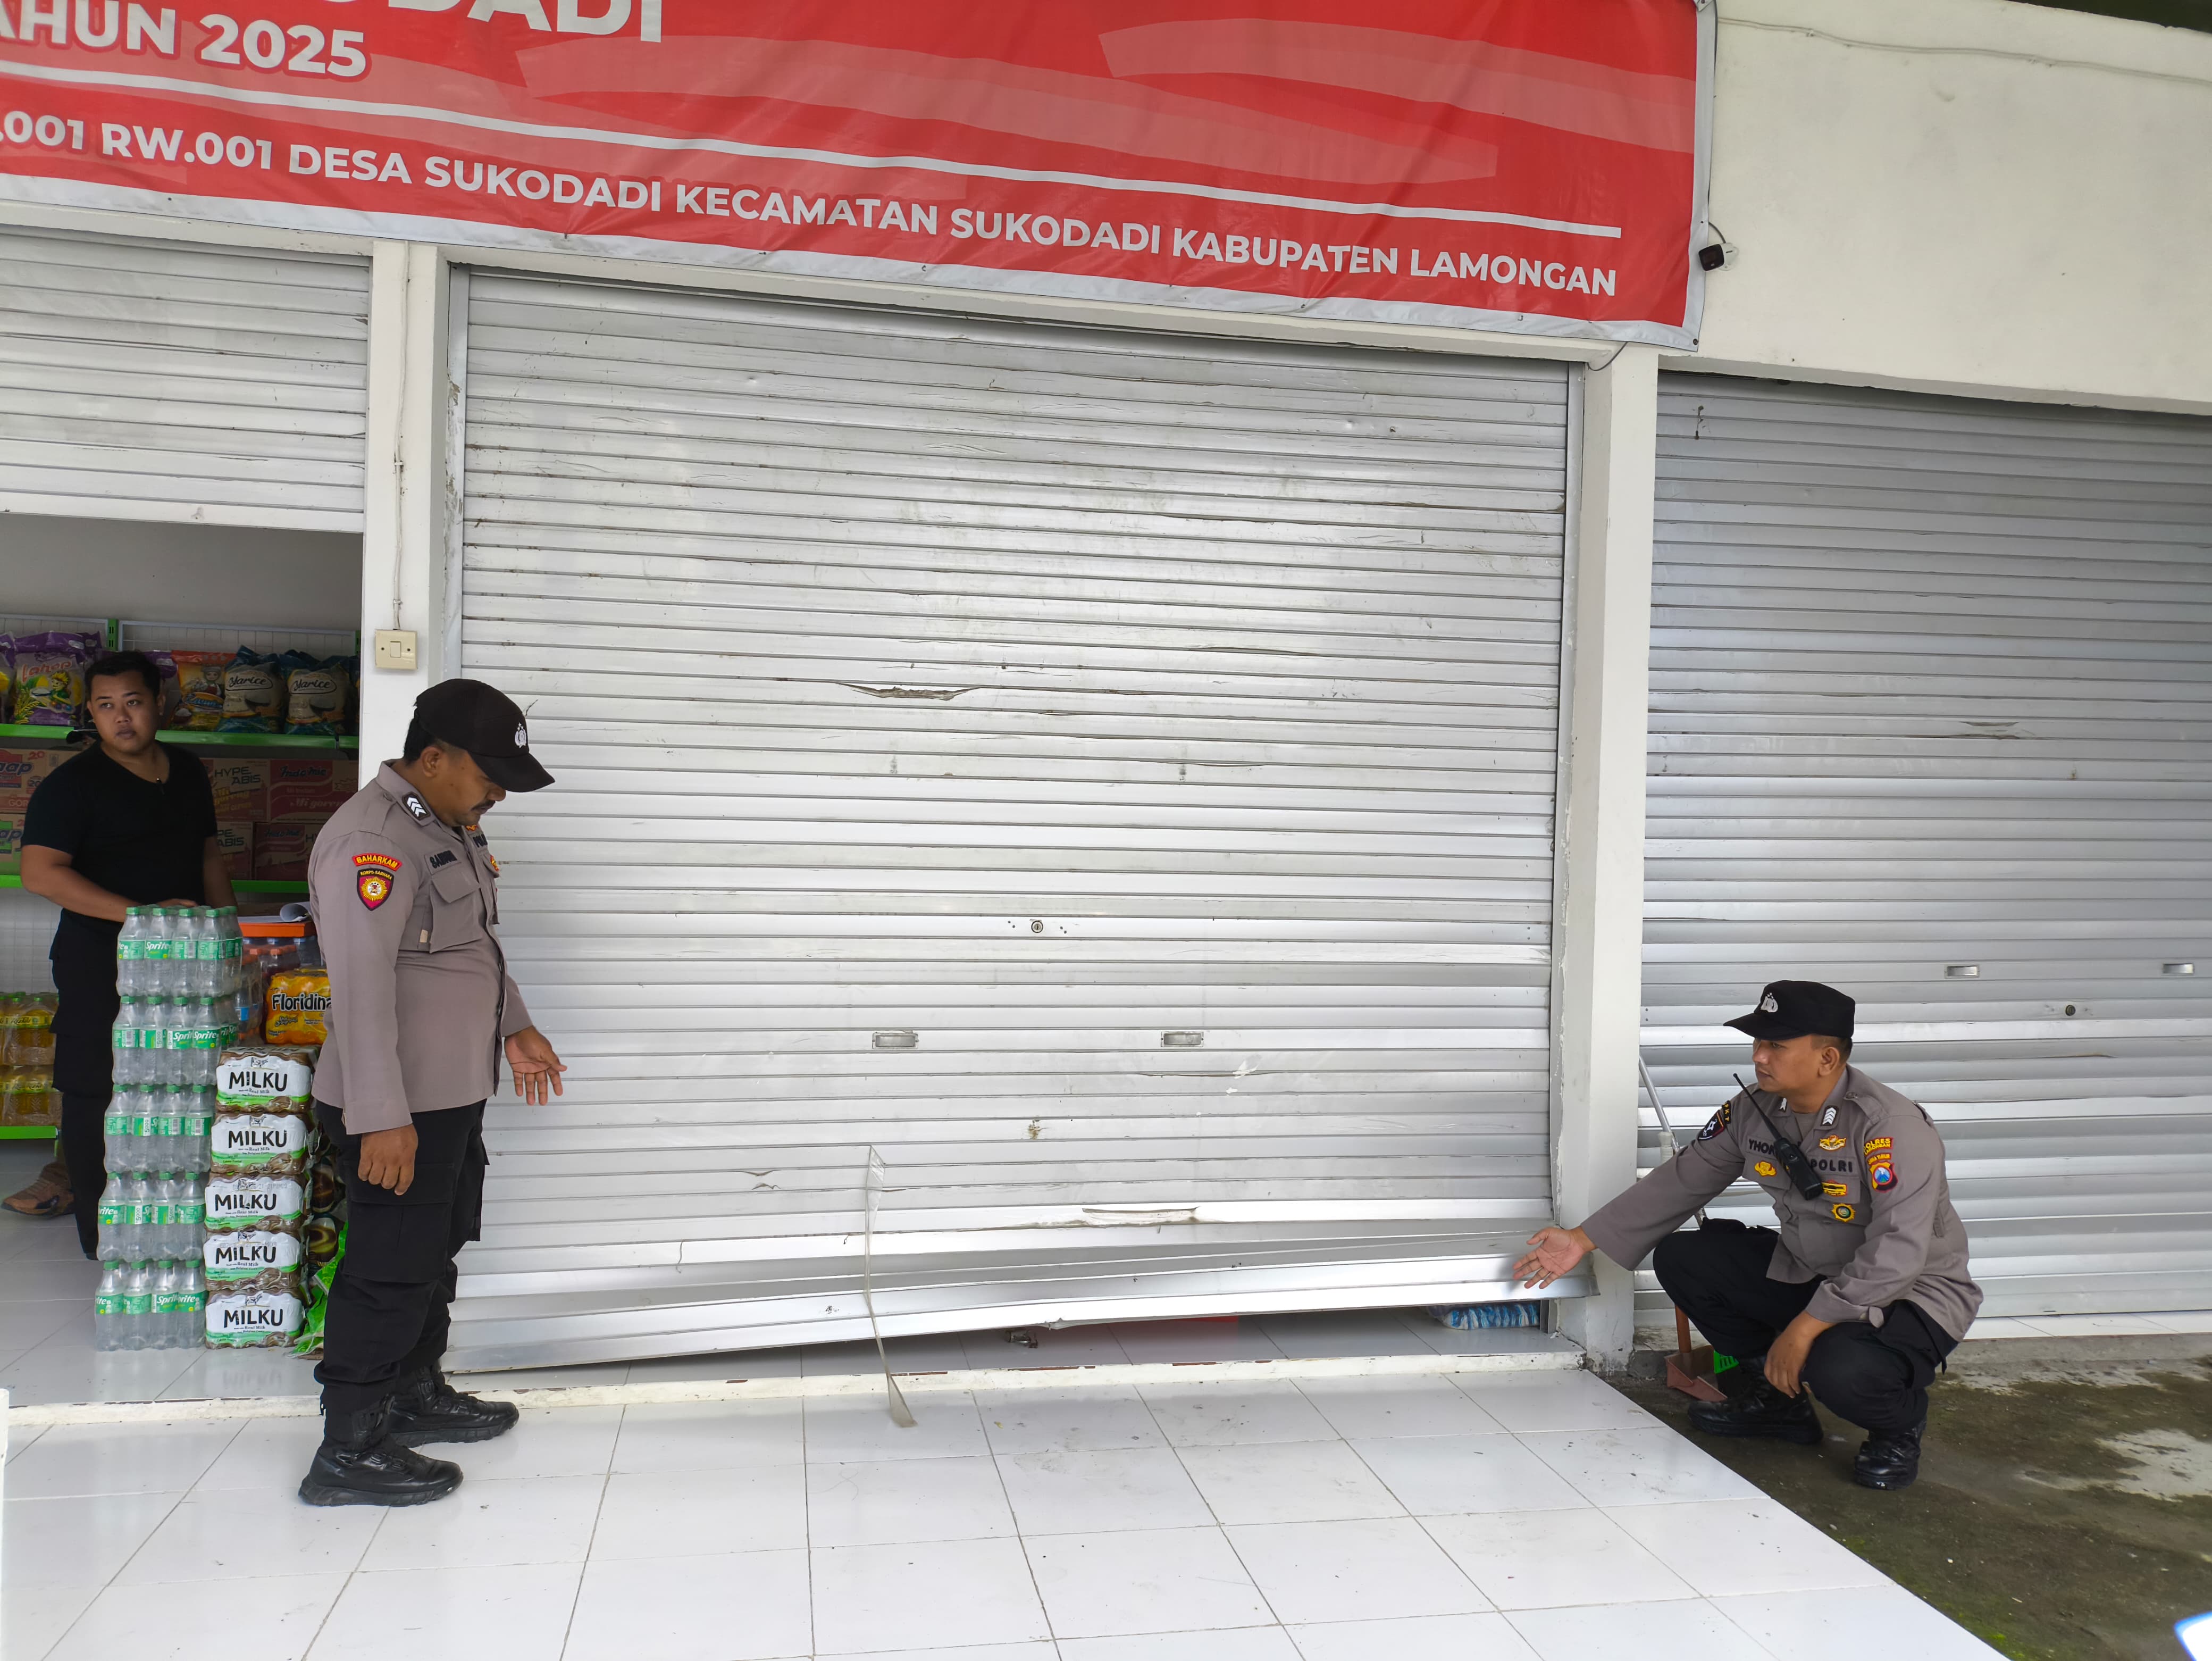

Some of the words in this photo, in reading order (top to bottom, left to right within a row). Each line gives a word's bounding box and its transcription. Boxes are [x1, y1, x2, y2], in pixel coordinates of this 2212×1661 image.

[200, 14, 367, 77] 2025
[102, 123, 273, 170] RW.001
[289, 145, 412, 184] DESA
[425, 156, 661, 212] SUKODADI
[676, 183, 938, 235] KECAMATAN
[950, 208, 1161, 254] SUKODADI
[1172, 228, 1398, 274] KABUPATEN
[1410, 249, 1616, 296] LAMONGAN
[215, 766, 251, 777] HYPE
[231, 774, 261, 785] ABIS
[356, 855, 397, 868] BAHARKAM
[146, 941, 169, 950] Sprite
[194, 1031, 217, 1039] Sprite
[229, 1071, 287, 1092] MILKU
[228, 1131, 287, 1148] MILKU
[1811, 1158, 1853, 1173] POLRI
[215, 1193, 277, 1212] MILKU
[215, 1246, 276, 1264] MILKU
[223, 1308, 283, 1328] MILKU
